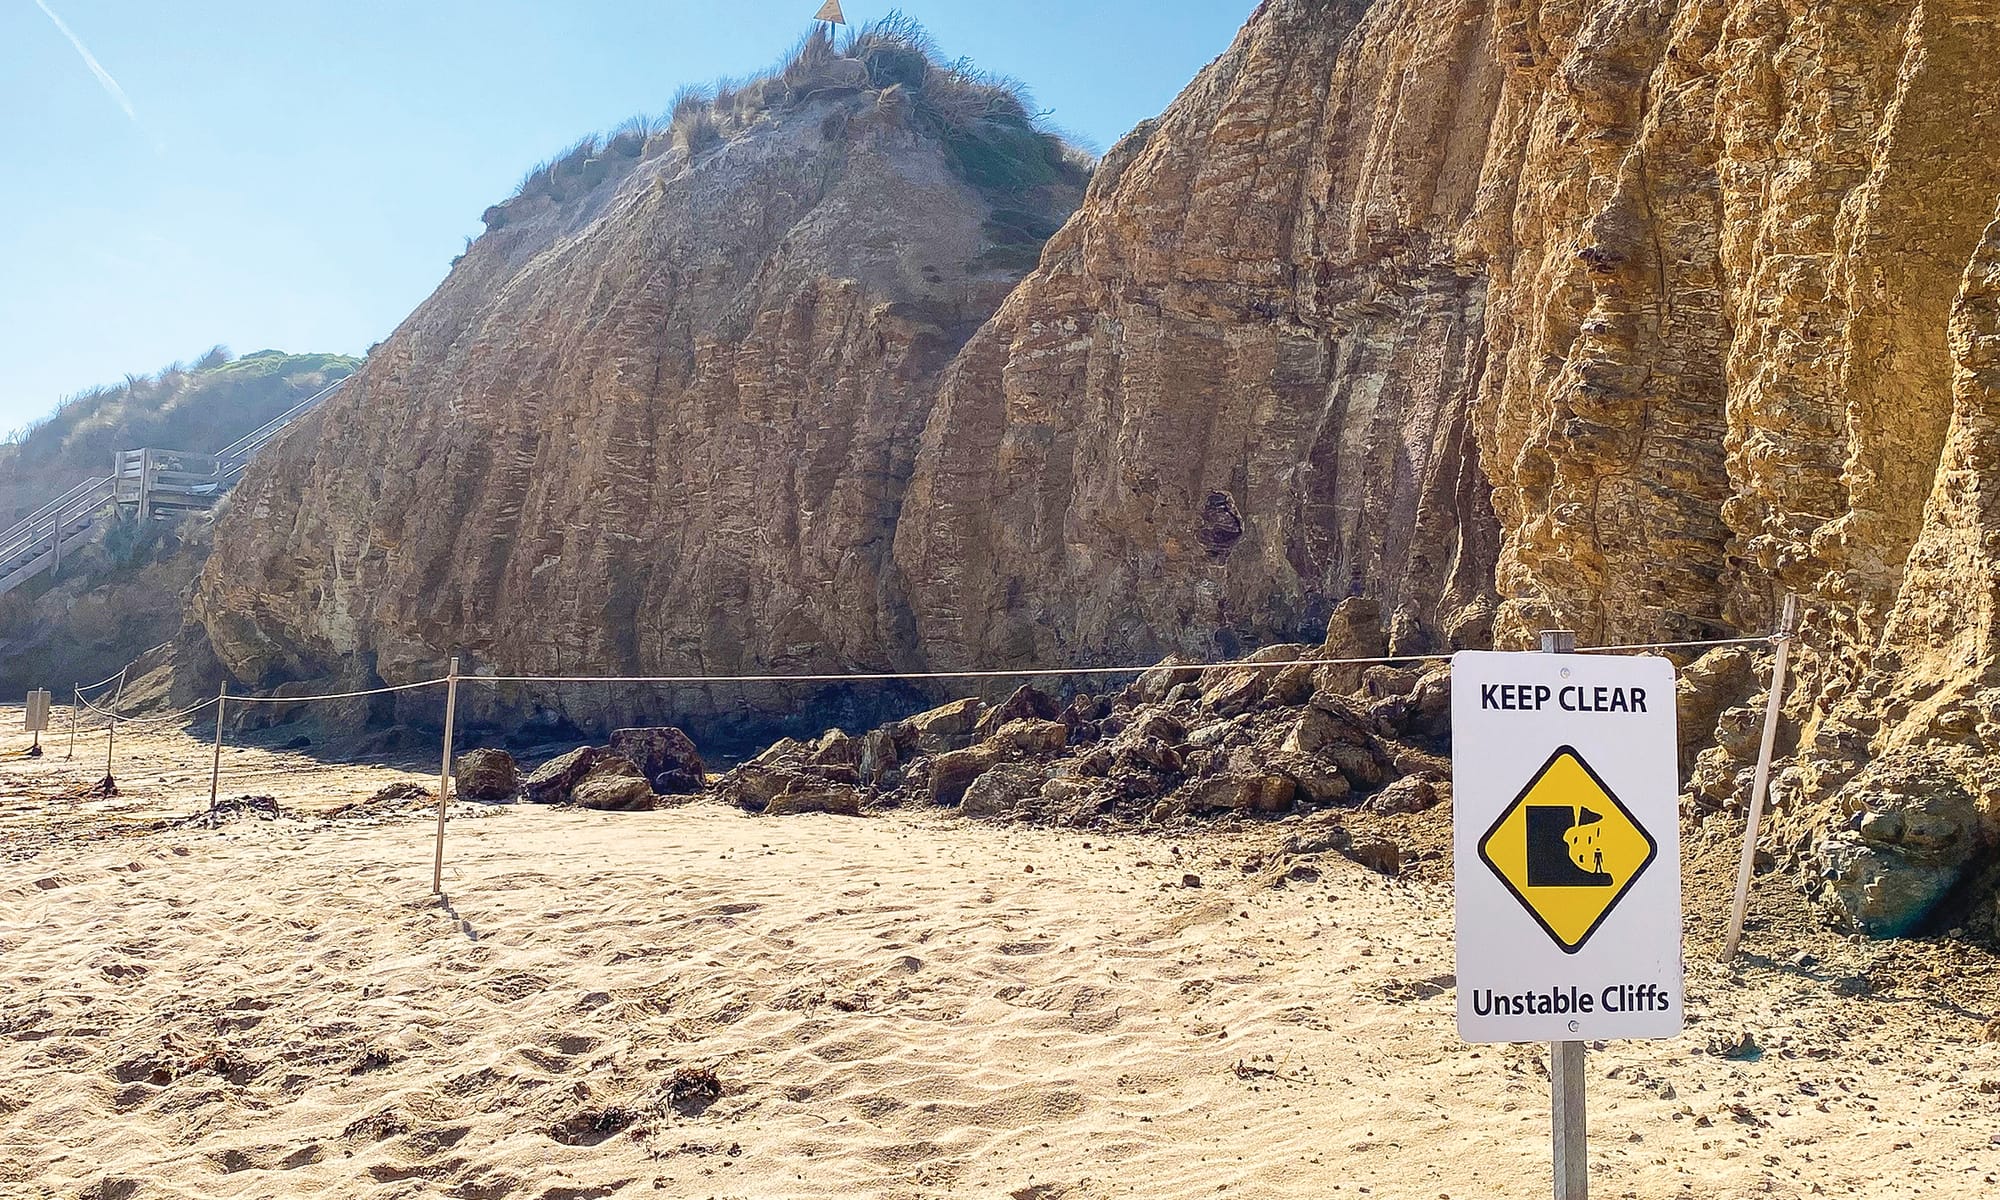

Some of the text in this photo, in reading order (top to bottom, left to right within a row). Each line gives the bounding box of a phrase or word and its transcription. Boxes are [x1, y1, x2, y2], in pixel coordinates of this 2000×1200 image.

[1481, 684, 1648, 713] KEEP CLEAR
[1473, 984, 1670, 1017] Unstable Cliffs
